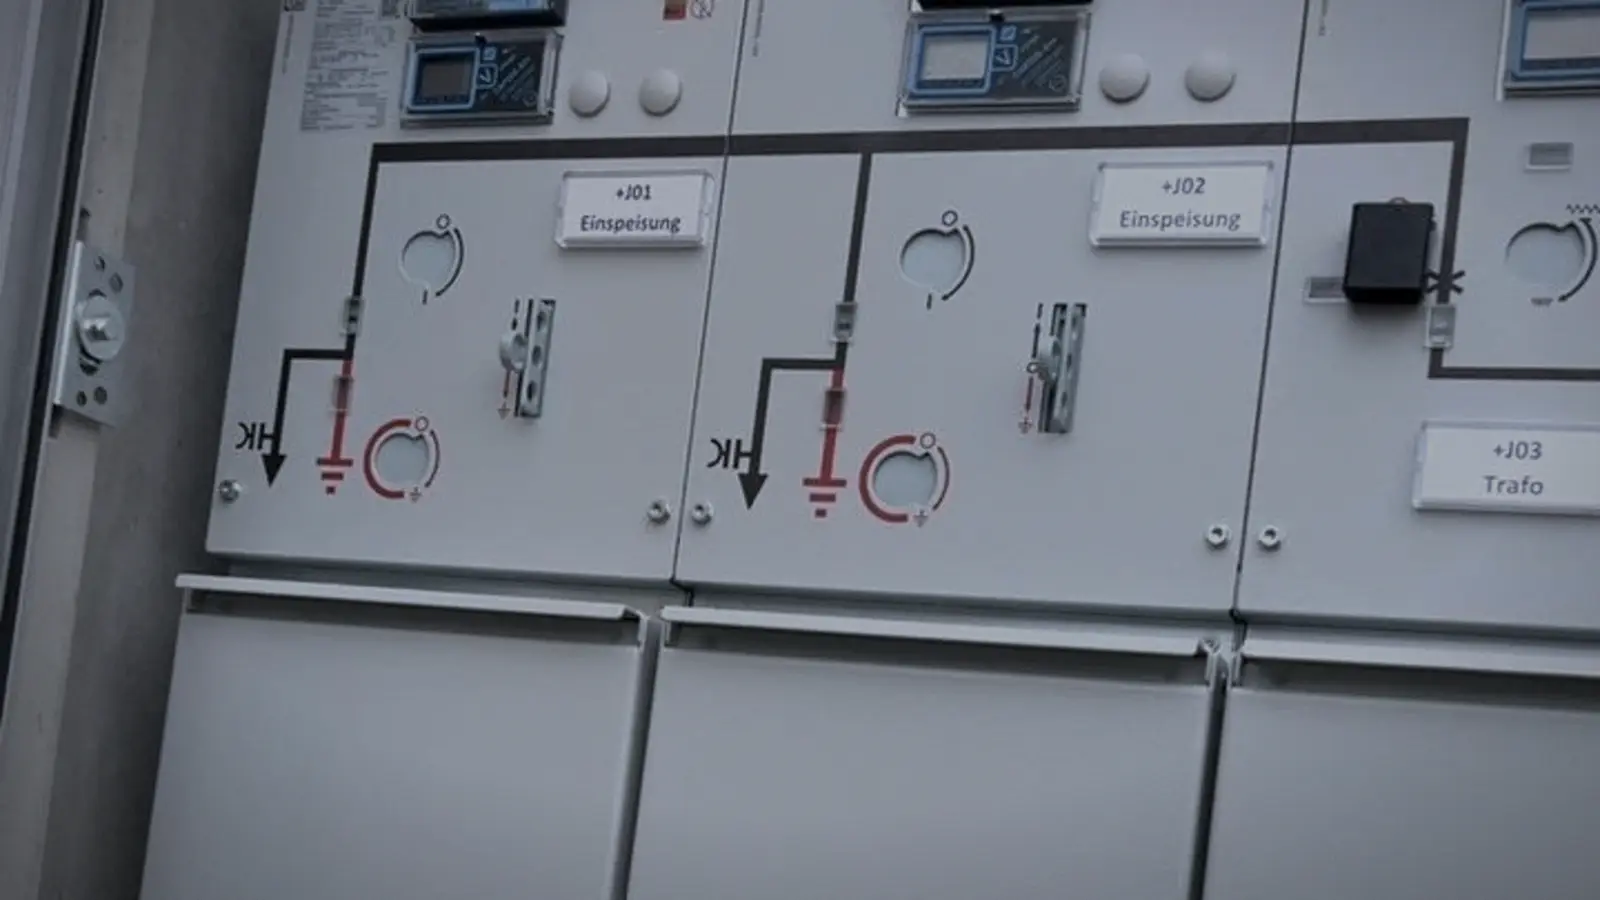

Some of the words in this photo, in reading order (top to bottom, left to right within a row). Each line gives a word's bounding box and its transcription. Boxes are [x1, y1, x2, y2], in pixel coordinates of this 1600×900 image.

[616, 184, 652, 200] +J01
[1162, 177, 1206, 195] +J02
[580, 214, 682, 234] Einspeisung
[1120, 208, 1241, 231] Einspeisung
[1492, 441, 1543, 460] +J03
[1484, 475, 1544, 496] Trafo
